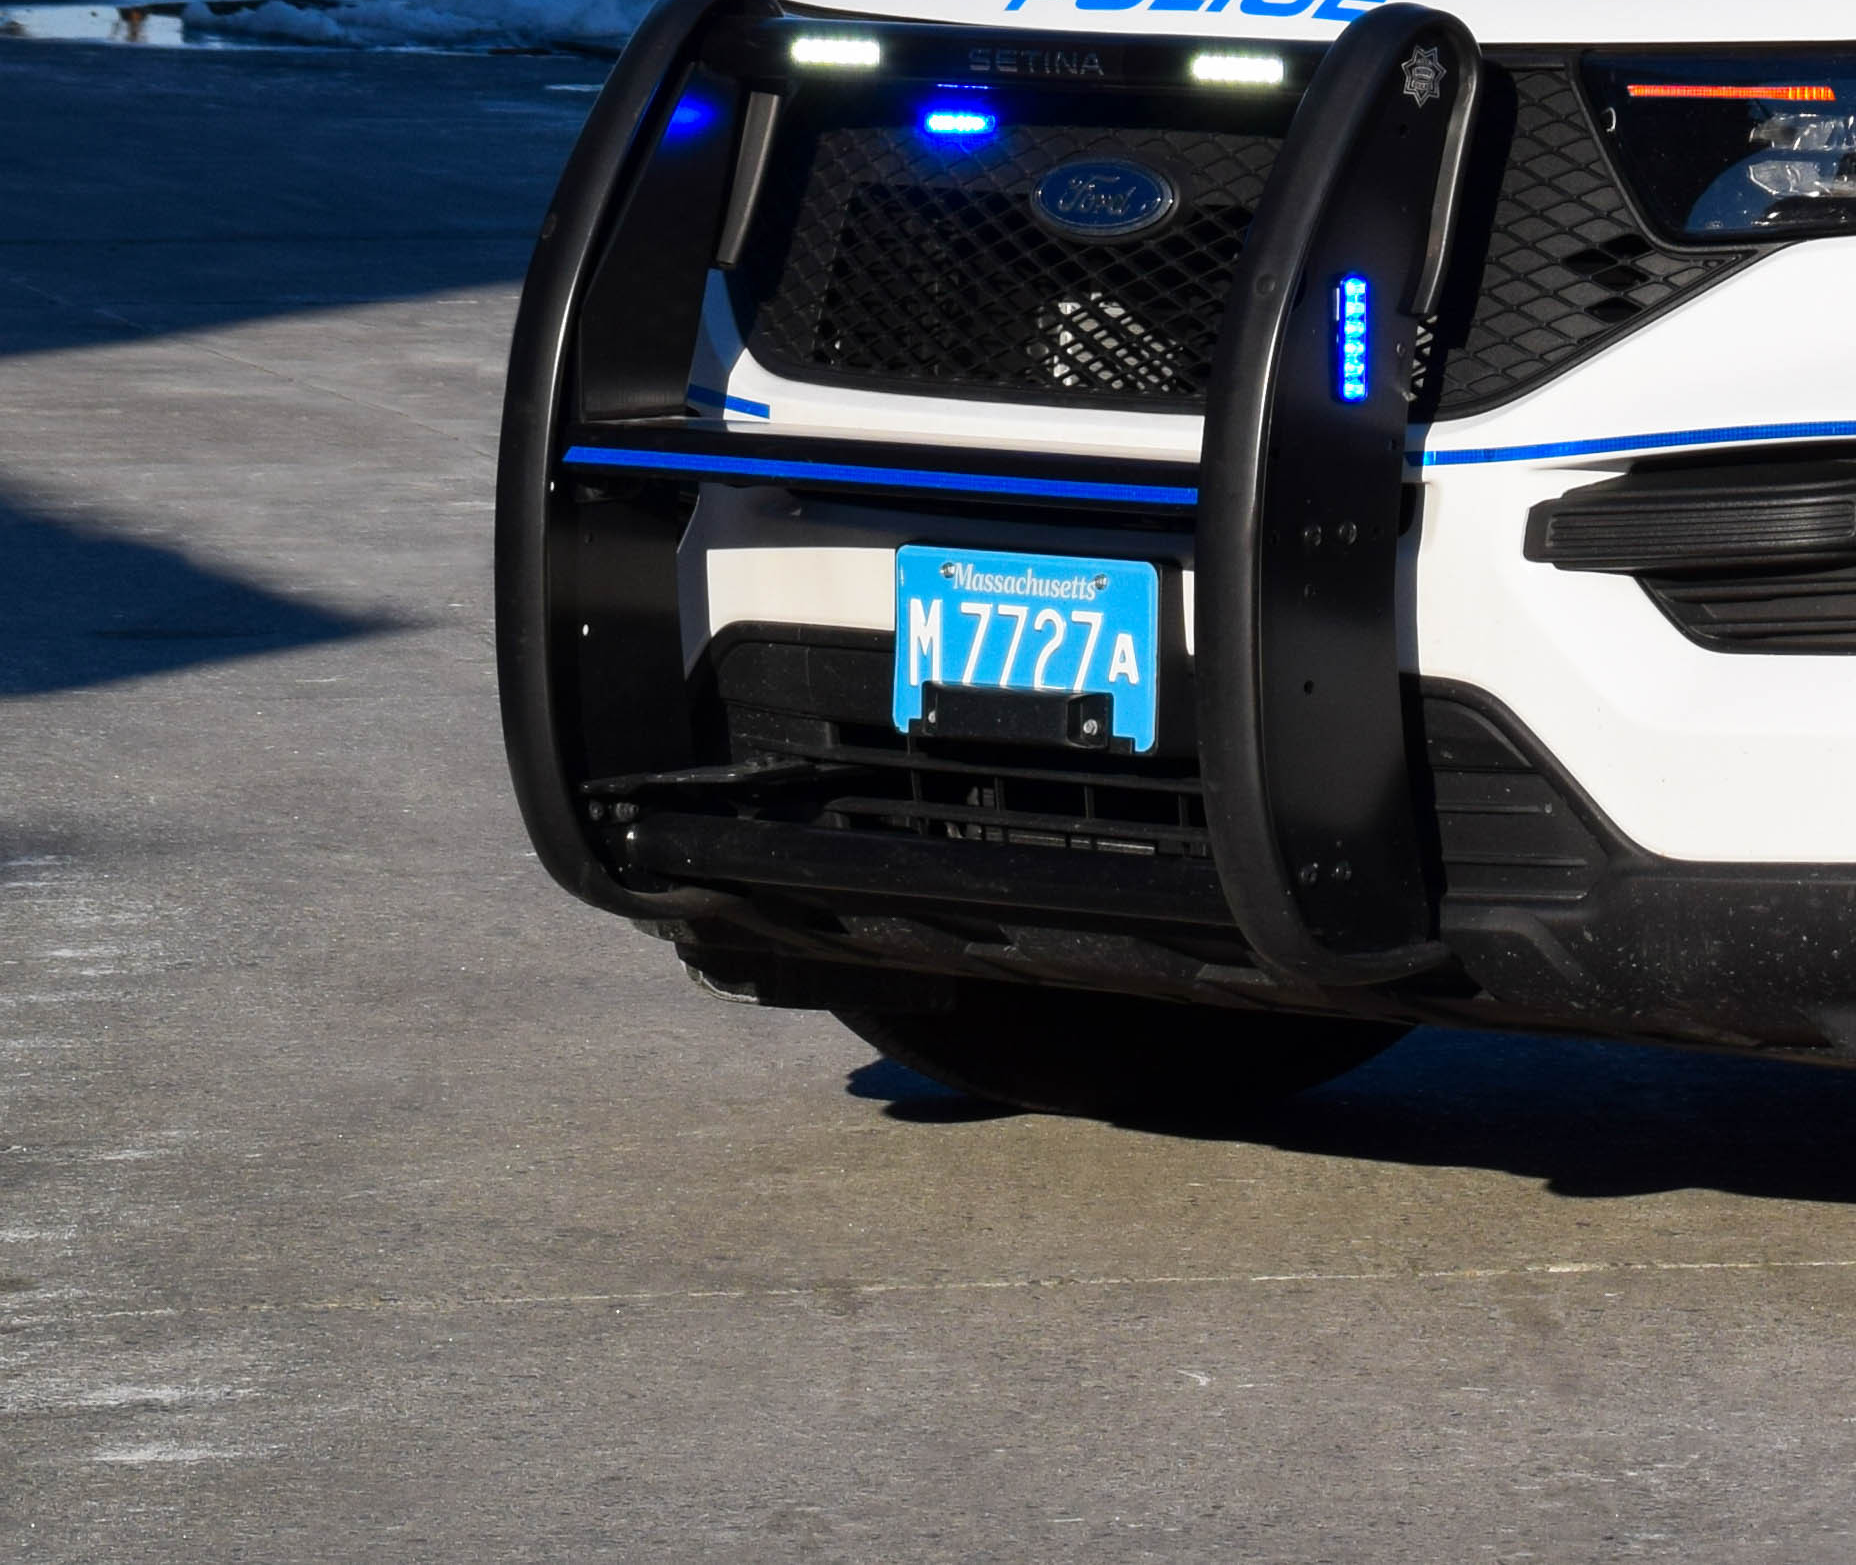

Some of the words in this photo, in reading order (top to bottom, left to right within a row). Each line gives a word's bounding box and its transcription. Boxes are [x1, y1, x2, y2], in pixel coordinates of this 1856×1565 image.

[969, 48, 1104, 76] SETINA
[1058, 176, 1137, 215] Ford
[952, 562, 1096, 601] Massachusetts
